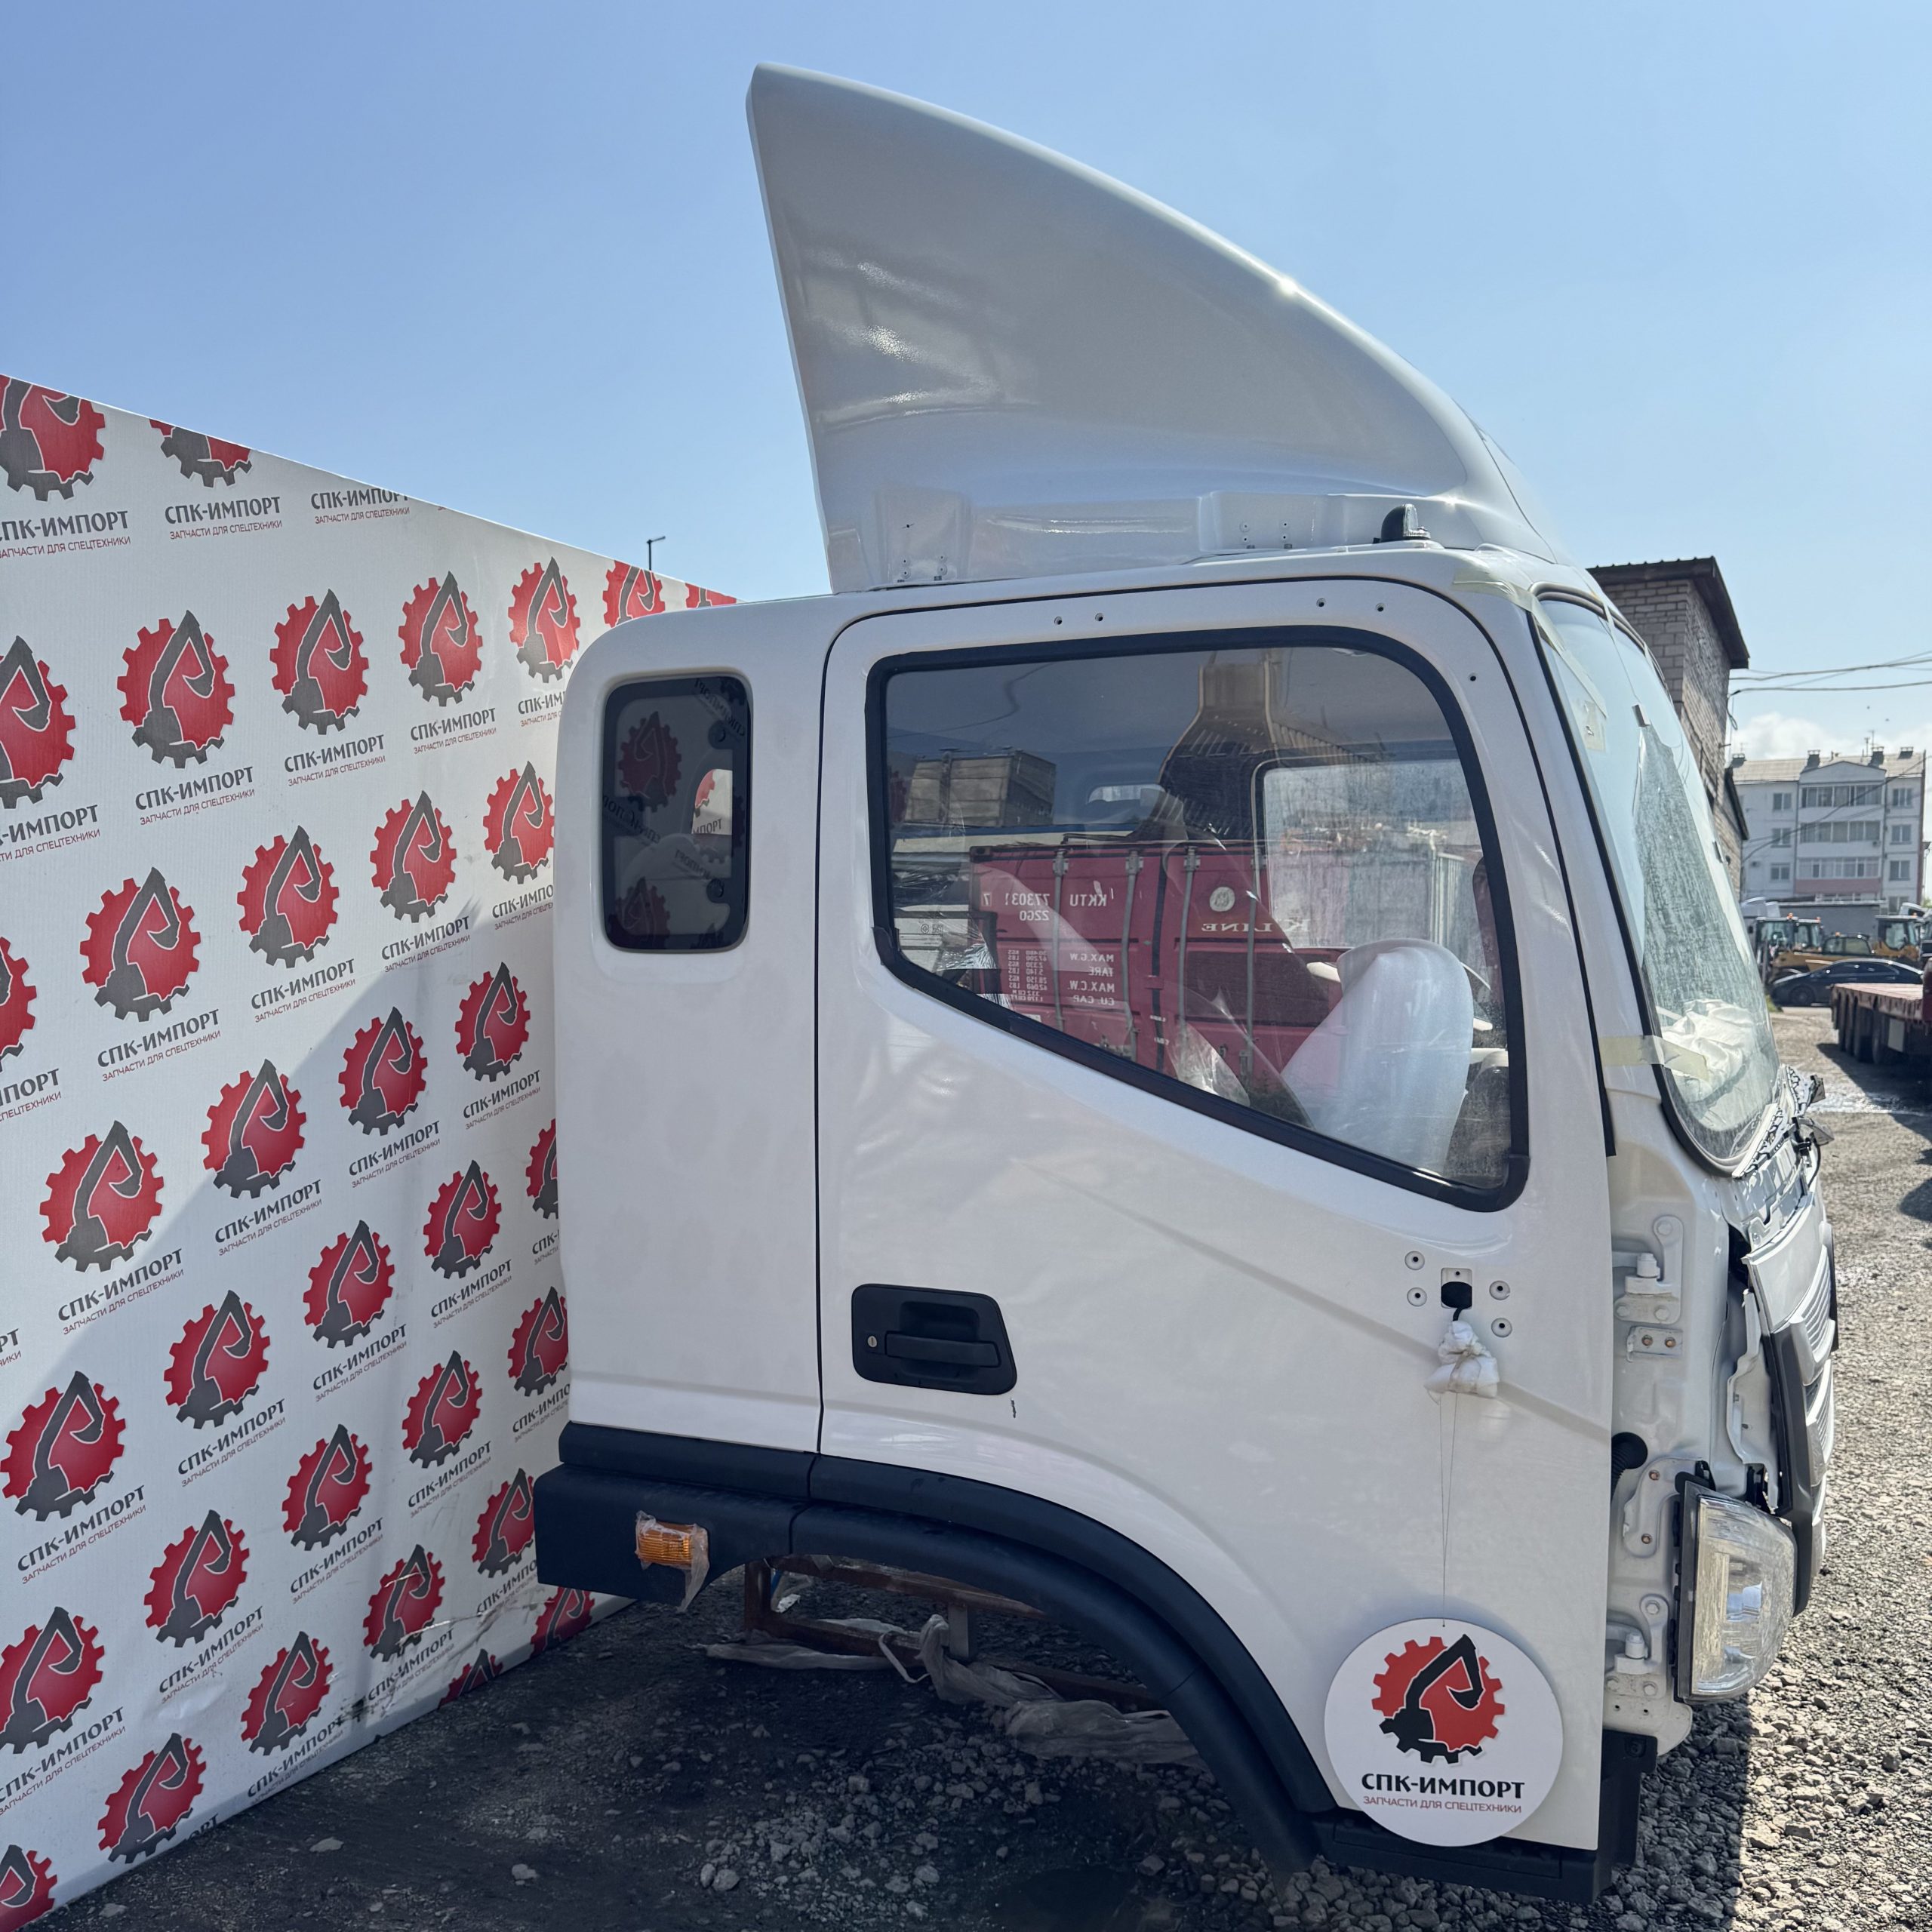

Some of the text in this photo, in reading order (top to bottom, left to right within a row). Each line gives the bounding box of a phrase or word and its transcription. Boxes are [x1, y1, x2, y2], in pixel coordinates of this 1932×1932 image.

[165, 497, 280, 525] СПК-ИМПОРТ
[311, 488, 408, 509] СПК-ИМПО
[315, 507, 410, 525] ЗАПЧАСТИ ДЛЯ СПЕЦТЕХНИКИ
[0, 510, 128, 542] ПК-ИМПОРТ
[47, 543, 66, 555] ДЛЯ
[67, 536, 131, 551] СПЕЦТЕХНИКИ
[170, 520, 282, 540] ЗАПЧАСТИ ДЛЯ СПЕЦТЕХНИКИ
[411, 707, 495, 741] СПК-ИМПОРТ
[518, 691, 565, 714] СПК-ИМ
[285, 734, 384, 773] СПК-ИМПОРТ
[414, 728, 497, 755] ЗАПЧАСТИ ДЛЯ СПЕЦТЕХНИКИ
[135, 766, 253, 810] СПК-ИМПОРТ
[288, 755, 386, 786] ЗАПЧАСТИ ДЛЯ СПЕЦТЕХНИКИ
[0, 804, 98, 846] -ИМПОРТ
[140, 789, 255, 826] ЗАПЧАСТИ ДЛЯ СПЕЦТЕХНИКИ
[14, 845, 34, 859] ДЛЯ
[35, 829, 100, 853] СПЕЦТЕХНИКИ
[492, 884, 554, 918] СПК-ИМПО
[381, 915, 469, 960] СПК-ИМПОРТ
[384, 934, 470, 973] ЗАПЧАСТИ ДЛЯ СПЕЦТЕХНИКИ
[251, 958, 354, 1009] СПК-ИМПОРТ
[254, 979, 355, 1023] ЗАПЧАСТИ ДЛЯ СПЕЦТЕХНИКИ
[97, 1008, 219, 1067] СПК-ИМПОРТ
[102, 1030, 221, 1081] ЗАПЧАСТИ ДЛЯ СПЕЦТЕХНИКИ
[0, 1091, 62, 1122] ПЕЦТЕХНИКИ
[463, 1069, 540, 1118] СПК-ИМПОРТ
[466, 1086, 540, 1130] ЗАПЧАСТИ ДЛЯ СПЕЦТЕХНИКИ
[349, 1120, 439, 1176] СПК-ИМПОРТ
[352, 1138, 440, 1188] ЗАПЧАСТИ ДЛЯ СПЕЦТЕХНИКИ
[215, 1179, 321, 1243] СПК-ИМПОРТ
[218, 1198, 322, 1256] ЗАПЧАСТИ ДЛЯ СПЕЦТЕХНИКИ
[58, 1248, 182, 1321] СПК-ИМПОРТ
[63, 1269, 184, 1335] ЗАПЧАСТИ ДЛЯ СПЕЦТЕХНИКИ
[431, 1259, 511, 1318] СПК-ИМПОРТ
[433, 1275, 512, 1329] ЗАПЧАСТИ ДЛЯ СПЕЦТЕХНИКИ
[313, 1324, 406, 1390] СПК-ИМПОРТ
[315, 1341, 407, 1402] ЗАПЧАСТИ ДЛЯ СПЕЦТЕХНИКИ
[512, 1384, 571, 1432] СПК-ИМПО
[178, 1398, 285, 1475] СПК-ИМПОРТ
[181, 1417, 285, 1487] ЗАПЧАСТИ ДЛЯ СПЕЦТЕХНИКИ
[408, 1441, 491, 1508] СПК-ИМПОРТ
[17, 1484, 144, 1571] СПК-ИМПОРТ
[22, 1504, 146, 1584] ЗАПЧАСТИ ДЛЯ СПЕЦТЕХНИКИ
[291, 1518, 383, 1593] СПК-ИМПОРТ
[293, 1534, 383, 1604] ЗАПЧАСТИ ДЛЯ СПЕЦТЕХНИКИ
[477, 1559, 537, 1614] СПК-ИМПО
[159, 1605, 263, 1693] СПК-ИМПОРТ
[162, 1623, 263, 1704] ЗАПЧАСТИ ДЛЯ СПЕЦТЕХНИКИ
[45, 1766, 63, 1785] ДЛЯ
[64, 1726, 126, 1769] СПЕЦТЕХНИКИ
[1361, 1774, 1524, 1798] СПК-ИМПОРТ
[1363, 1795, 1521, 1813] ЗАПЧАСТИ ДЛЯ СПЕЦТЕХНИКИ
